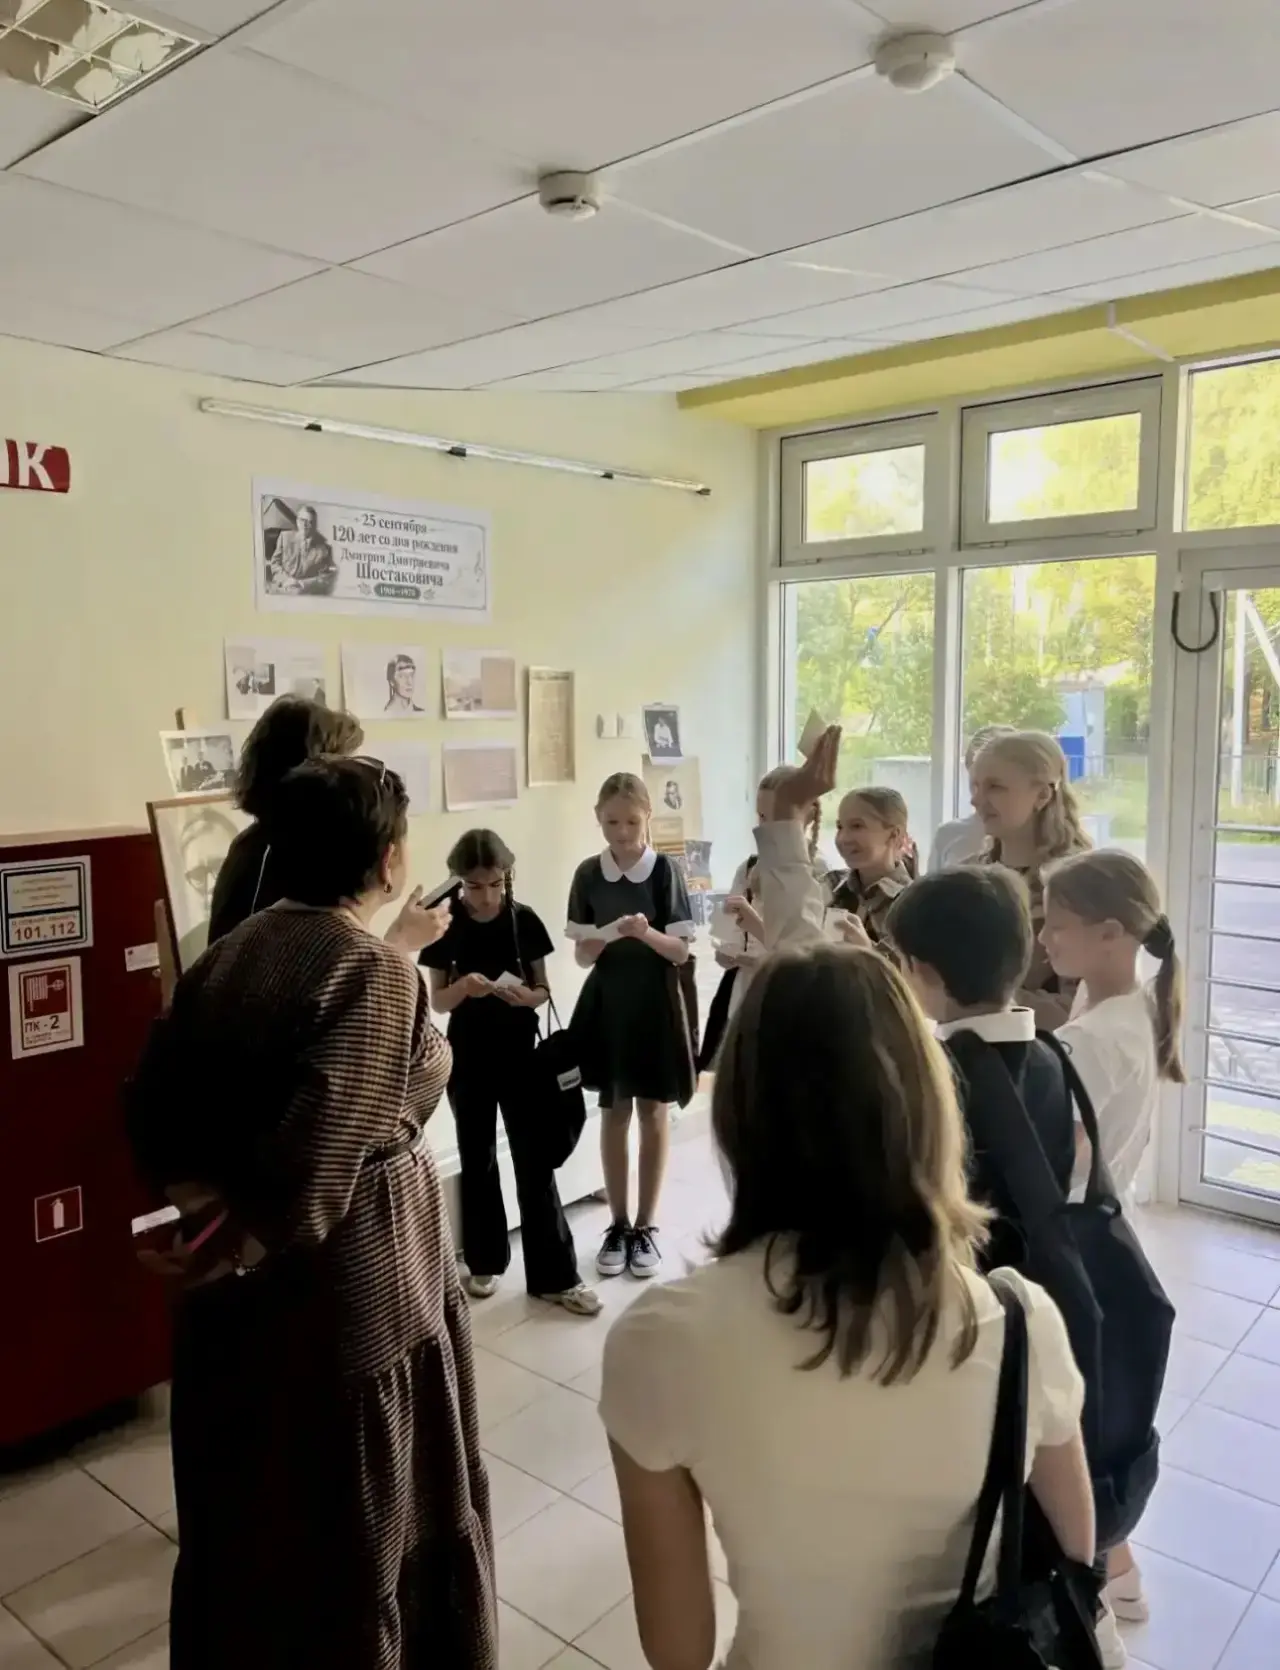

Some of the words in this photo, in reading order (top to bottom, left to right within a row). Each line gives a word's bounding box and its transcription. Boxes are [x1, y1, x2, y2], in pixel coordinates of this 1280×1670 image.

[362, 513, 376, 527] 25
[379, 518, 427, 534] сентября
[332, 525, 355, 542] 120
[358, 533, 376, 545] лет
[379, 535, 391, 545] со
[392, 536, 410, 548] дня
[412, 539, 459, 554] рождения
[340, 548, 385, 564] Дмитрия
[388, 552, 450, 571] Дмитриевича
[356, 562, 444, 586] Шостаковича
[50, 921, 76, 936] 112
[24, 1020, 40, 1033] ПК
[49, 1014, 60, 1029] 2
